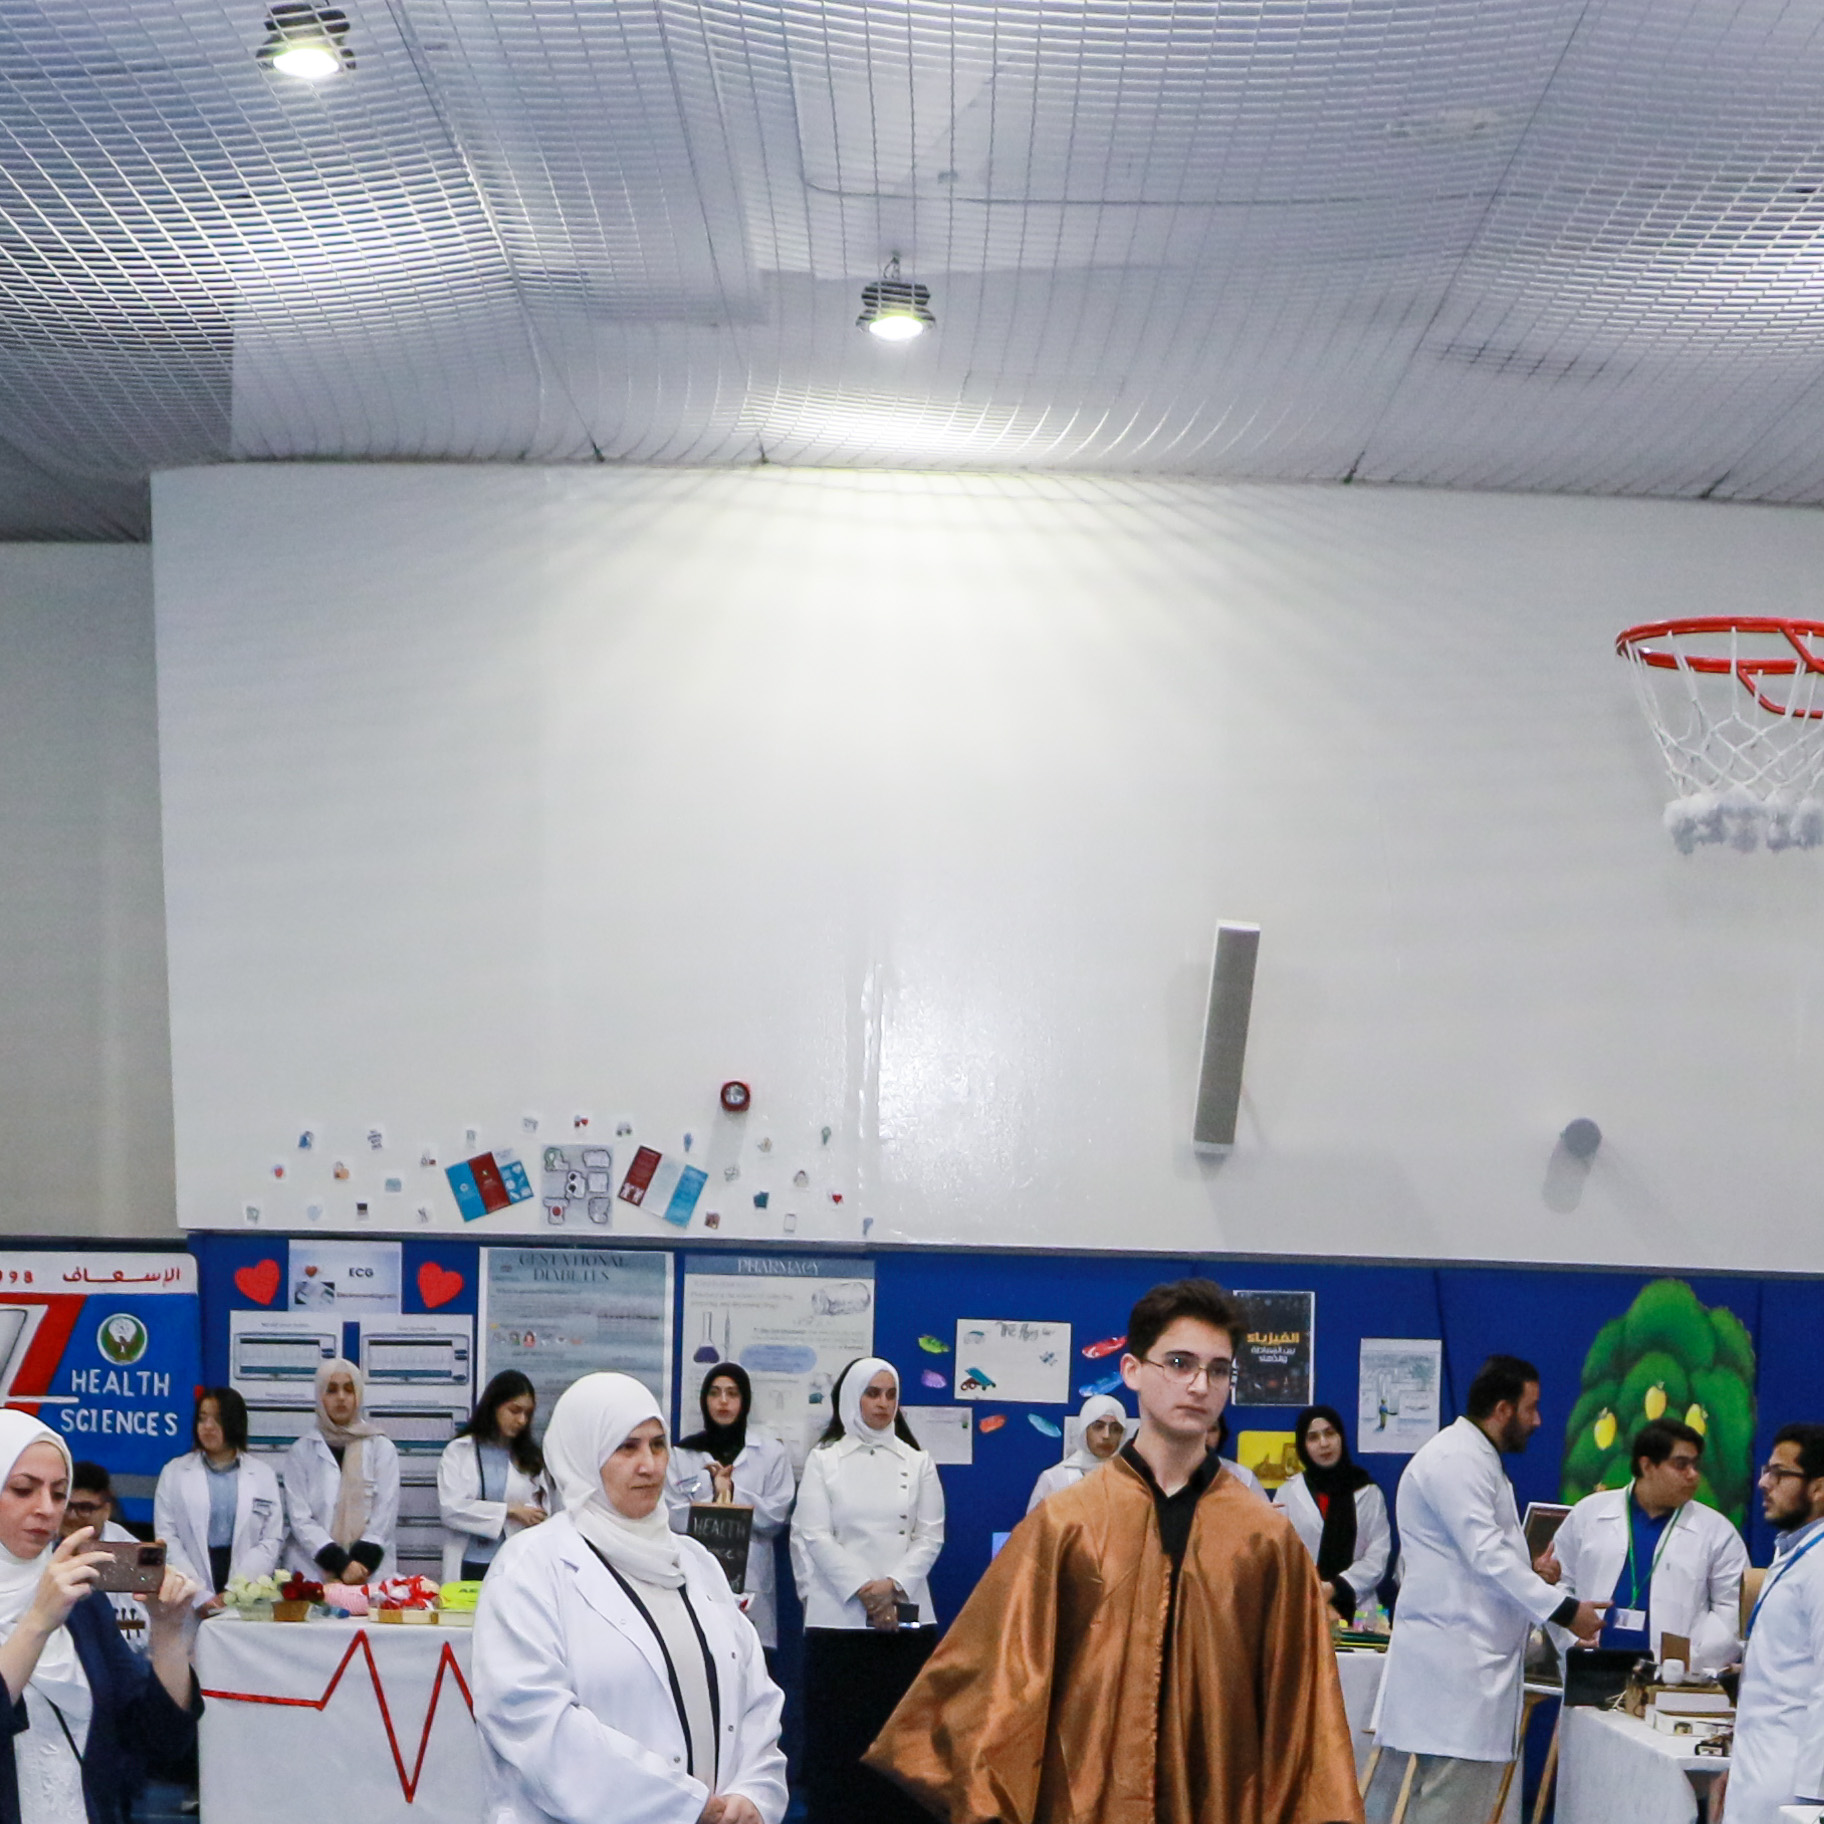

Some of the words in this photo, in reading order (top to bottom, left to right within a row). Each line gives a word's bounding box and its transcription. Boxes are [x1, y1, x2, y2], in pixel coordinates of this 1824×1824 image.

[518, 1253, 625, 1268] GESTATIONAL
[737, 1258, 819, 1276] PHARMACY
[62, 1267, 181, 1287] الإسعاف
[348, 1266, 374, 1278] ECG
[533, 1268, 610, 1282] DIABETES
[70, 1369, 170, 1398] HEALTH
[60, 1408, 178, 1437] SCIENCES
[693, 1516, 747, 1538] HEALTH
